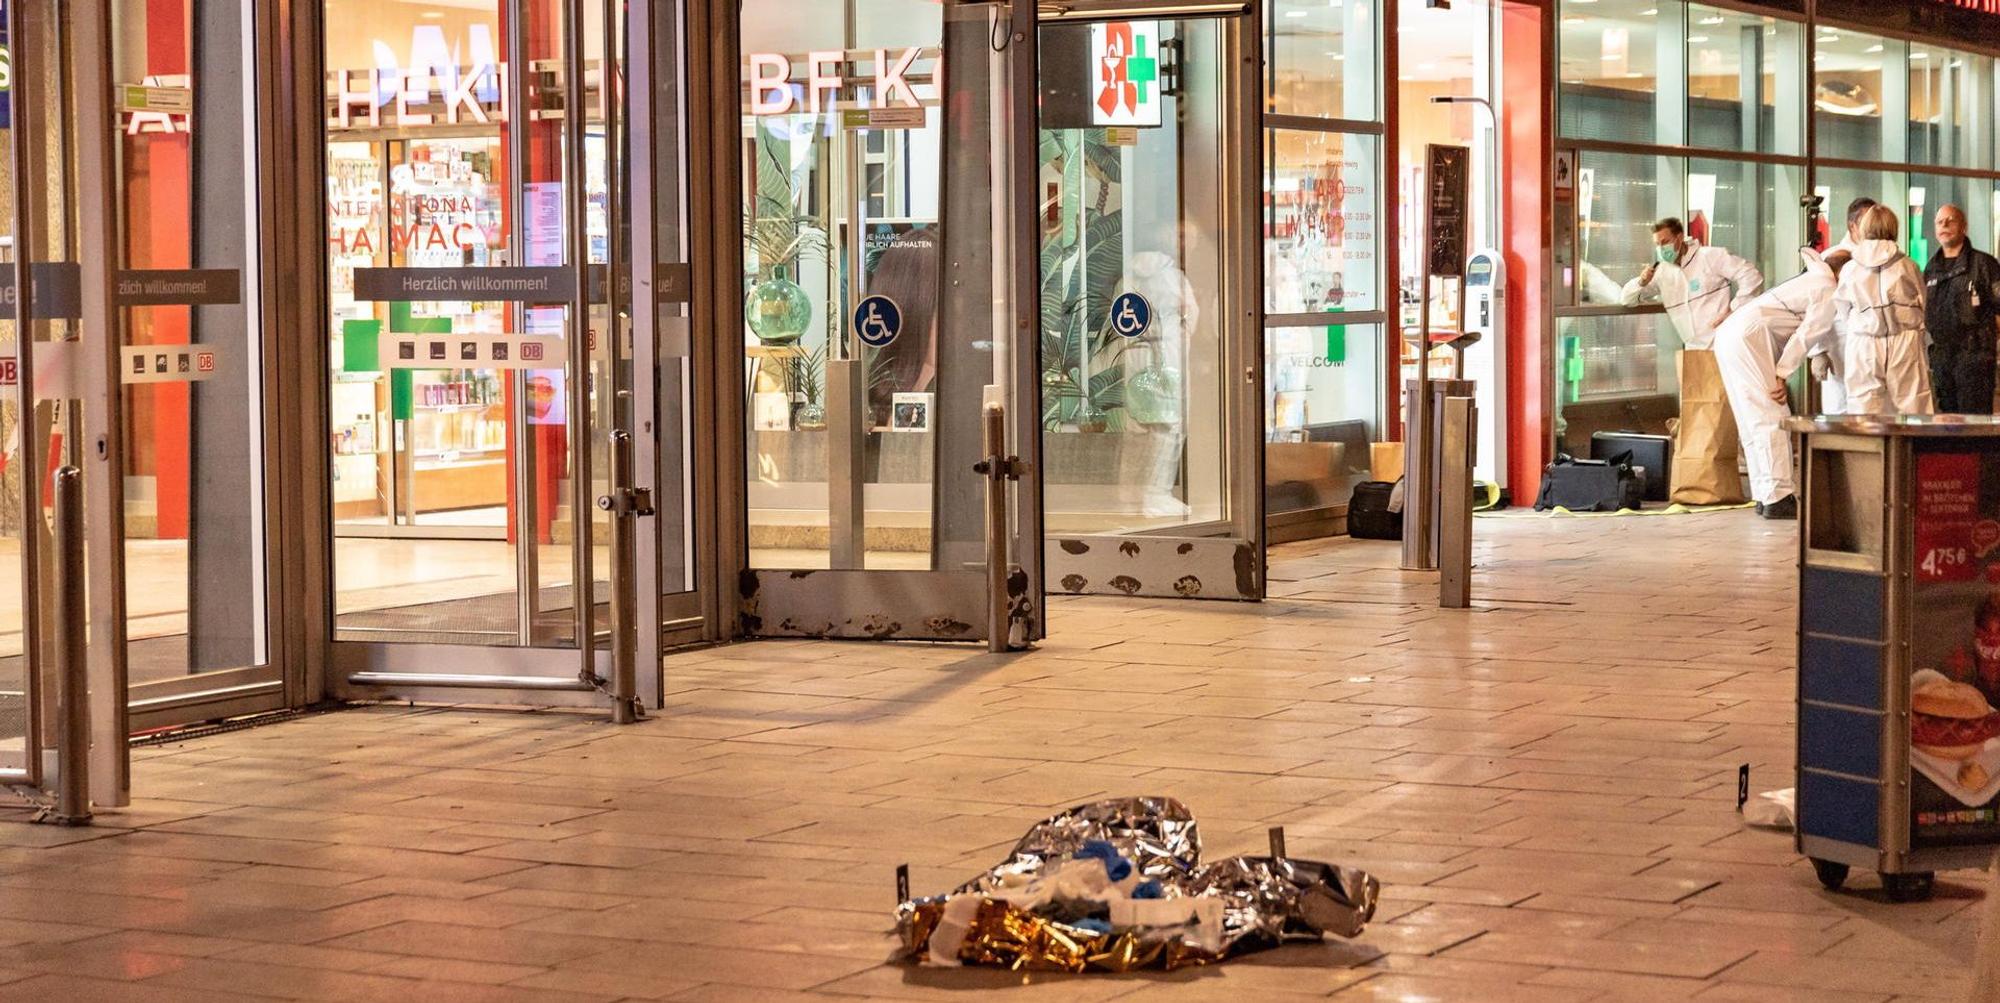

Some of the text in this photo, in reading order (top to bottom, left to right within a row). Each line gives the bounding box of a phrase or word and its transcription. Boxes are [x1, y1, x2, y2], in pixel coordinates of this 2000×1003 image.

[875, 46, 942, 109] K
[145, 279, 206, 294] willkommen!
[403, 277, 548, 291] Herzlich willkommen!
[522, 344, 542, 359] DB
[199, 355, 213, 369] DB
[1741, 774, 1746, 798] 2
